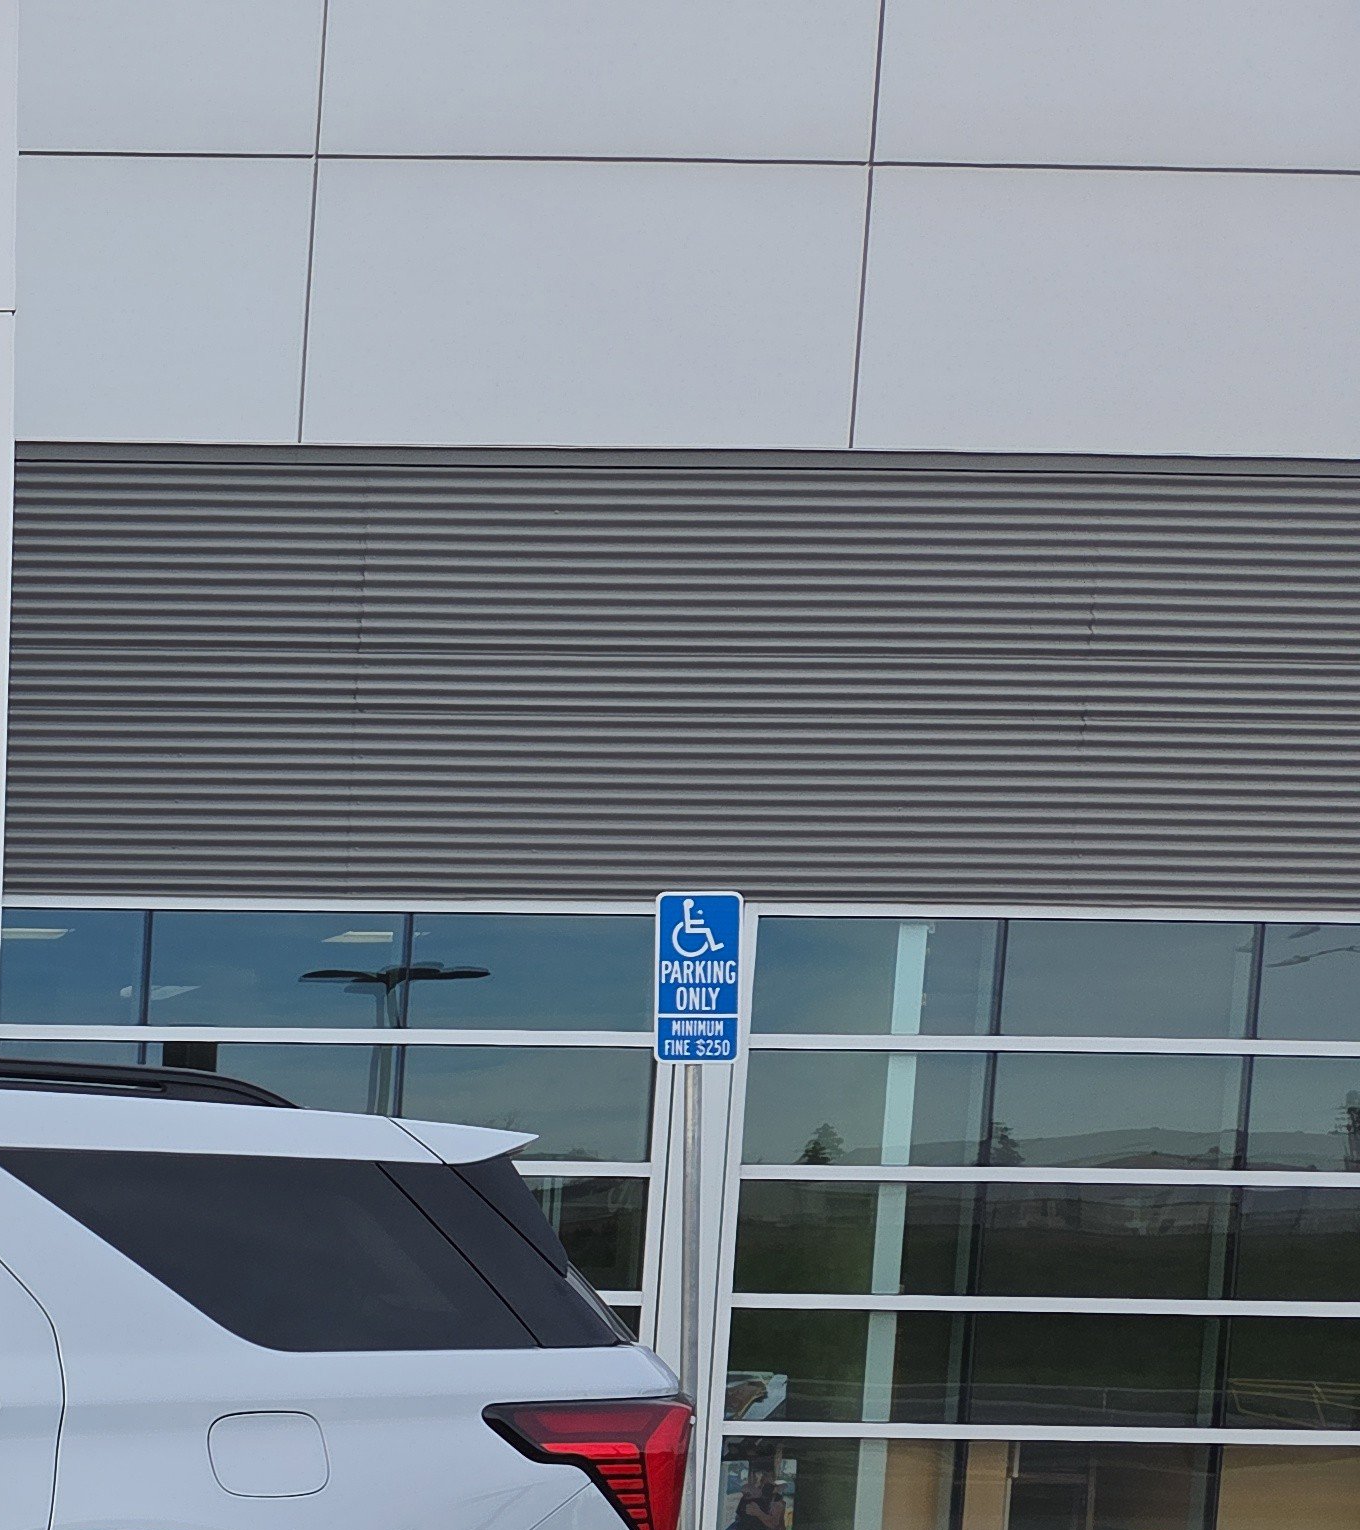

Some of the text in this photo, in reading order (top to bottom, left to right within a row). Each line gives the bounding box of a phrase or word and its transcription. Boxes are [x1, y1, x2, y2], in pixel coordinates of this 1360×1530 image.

[661, 960, 737, 984] PARKING
[676, 986, 720, 1011] ONLY
[671, 1020, 724, 1037] MINIMUM
[664, 1038, 731, 1057] FINE $250
